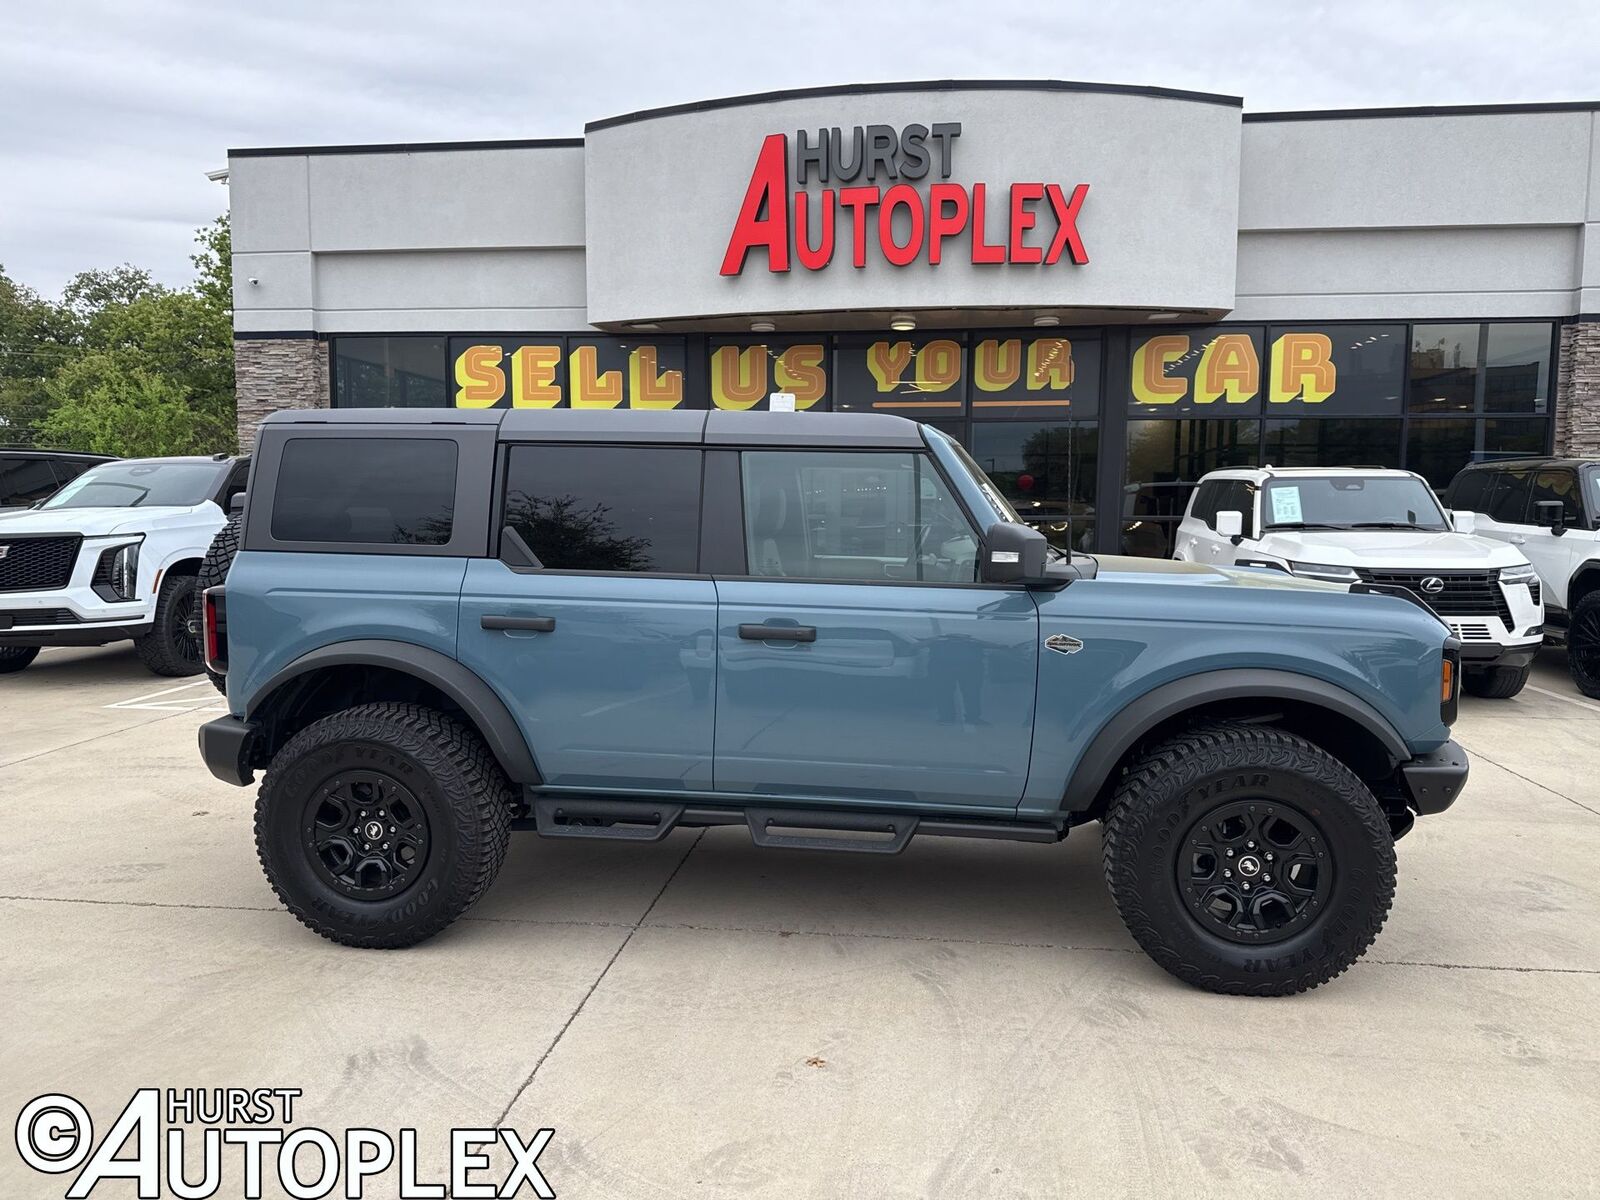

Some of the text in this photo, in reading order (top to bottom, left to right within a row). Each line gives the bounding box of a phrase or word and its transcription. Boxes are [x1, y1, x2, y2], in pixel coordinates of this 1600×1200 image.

[797, 123, 962, 184] HURST
[720, 133, 1090, 277] AUTOPLEX
[455, 333, 1337, 410] SELL US YOUR CAR
